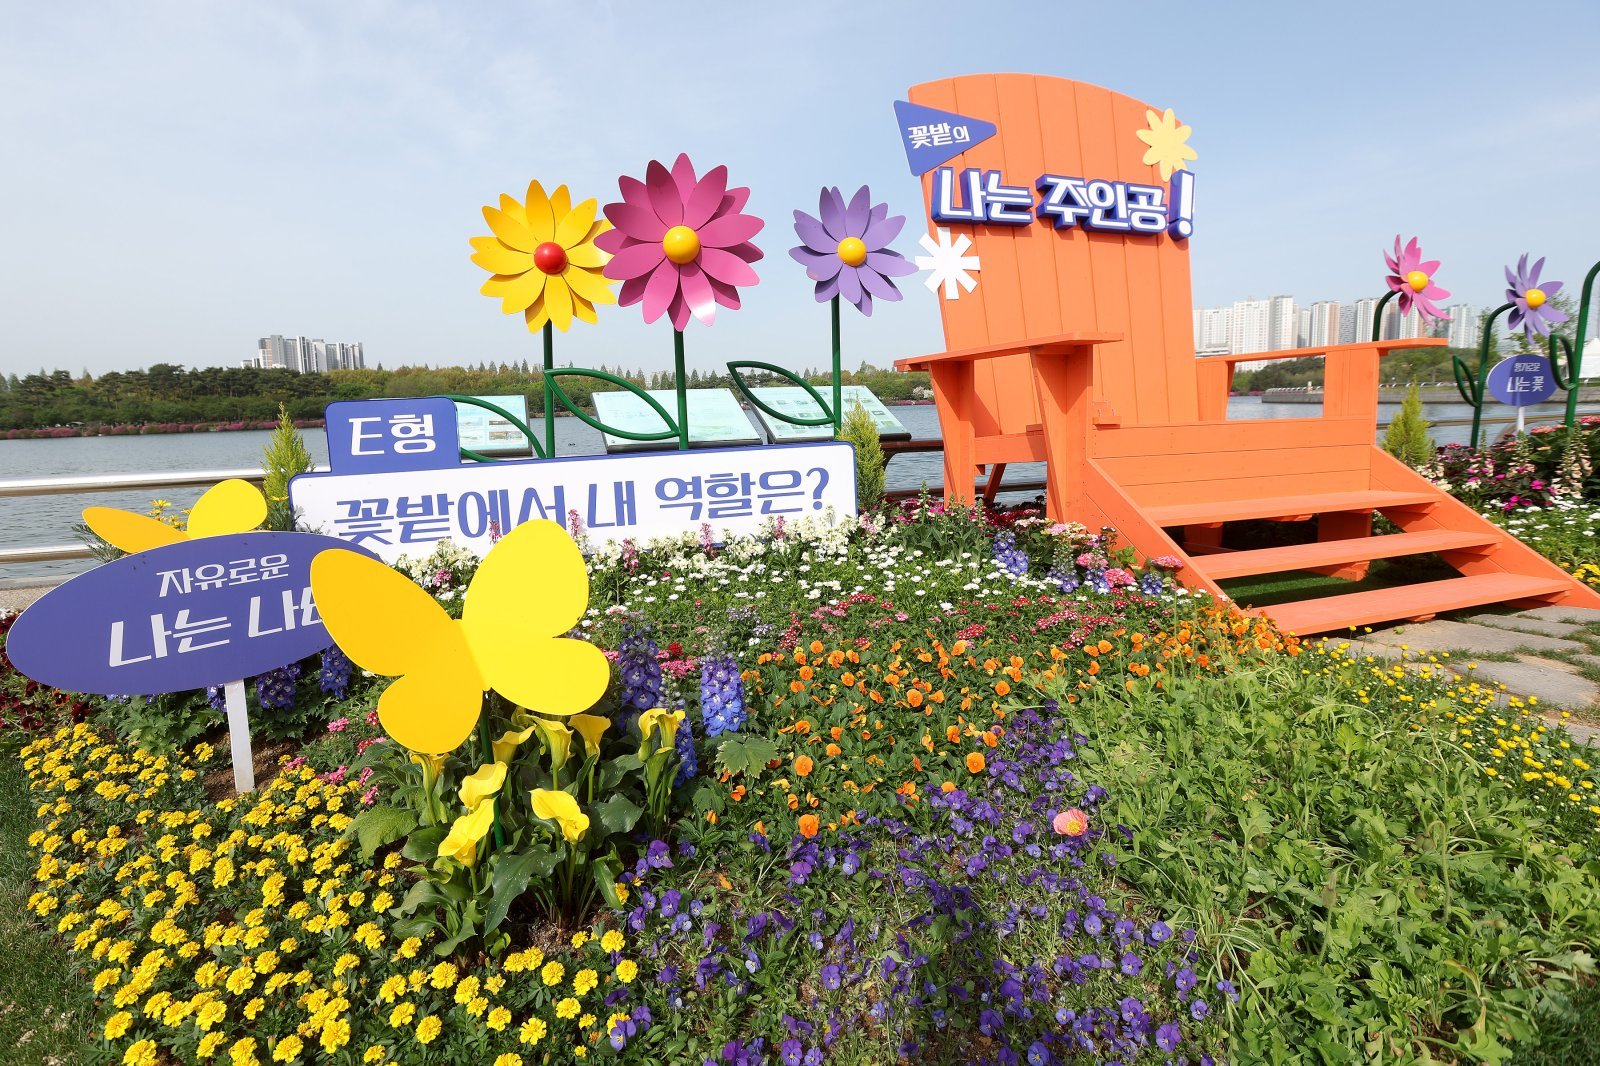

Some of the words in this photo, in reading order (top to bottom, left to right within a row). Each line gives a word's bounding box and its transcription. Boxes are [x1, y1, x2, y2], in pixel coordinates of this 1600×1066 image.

[907, 122, 970, 149] 꽃밭의
[935, 167, 1033, 224] 나는
[1506, 376, 1531, 393] 나는
[1531, 376, 1545, 392] 꽃
[348, 413, 437, 456] E형
[334, 485, 564, 545] 꽃밭에서
[586, 480, 636, 529] 내
[654, 466, 831, 521] 역할은?
[156, 553, 290, 598] 자유로운
[108, 608, 232, 668] 나는
